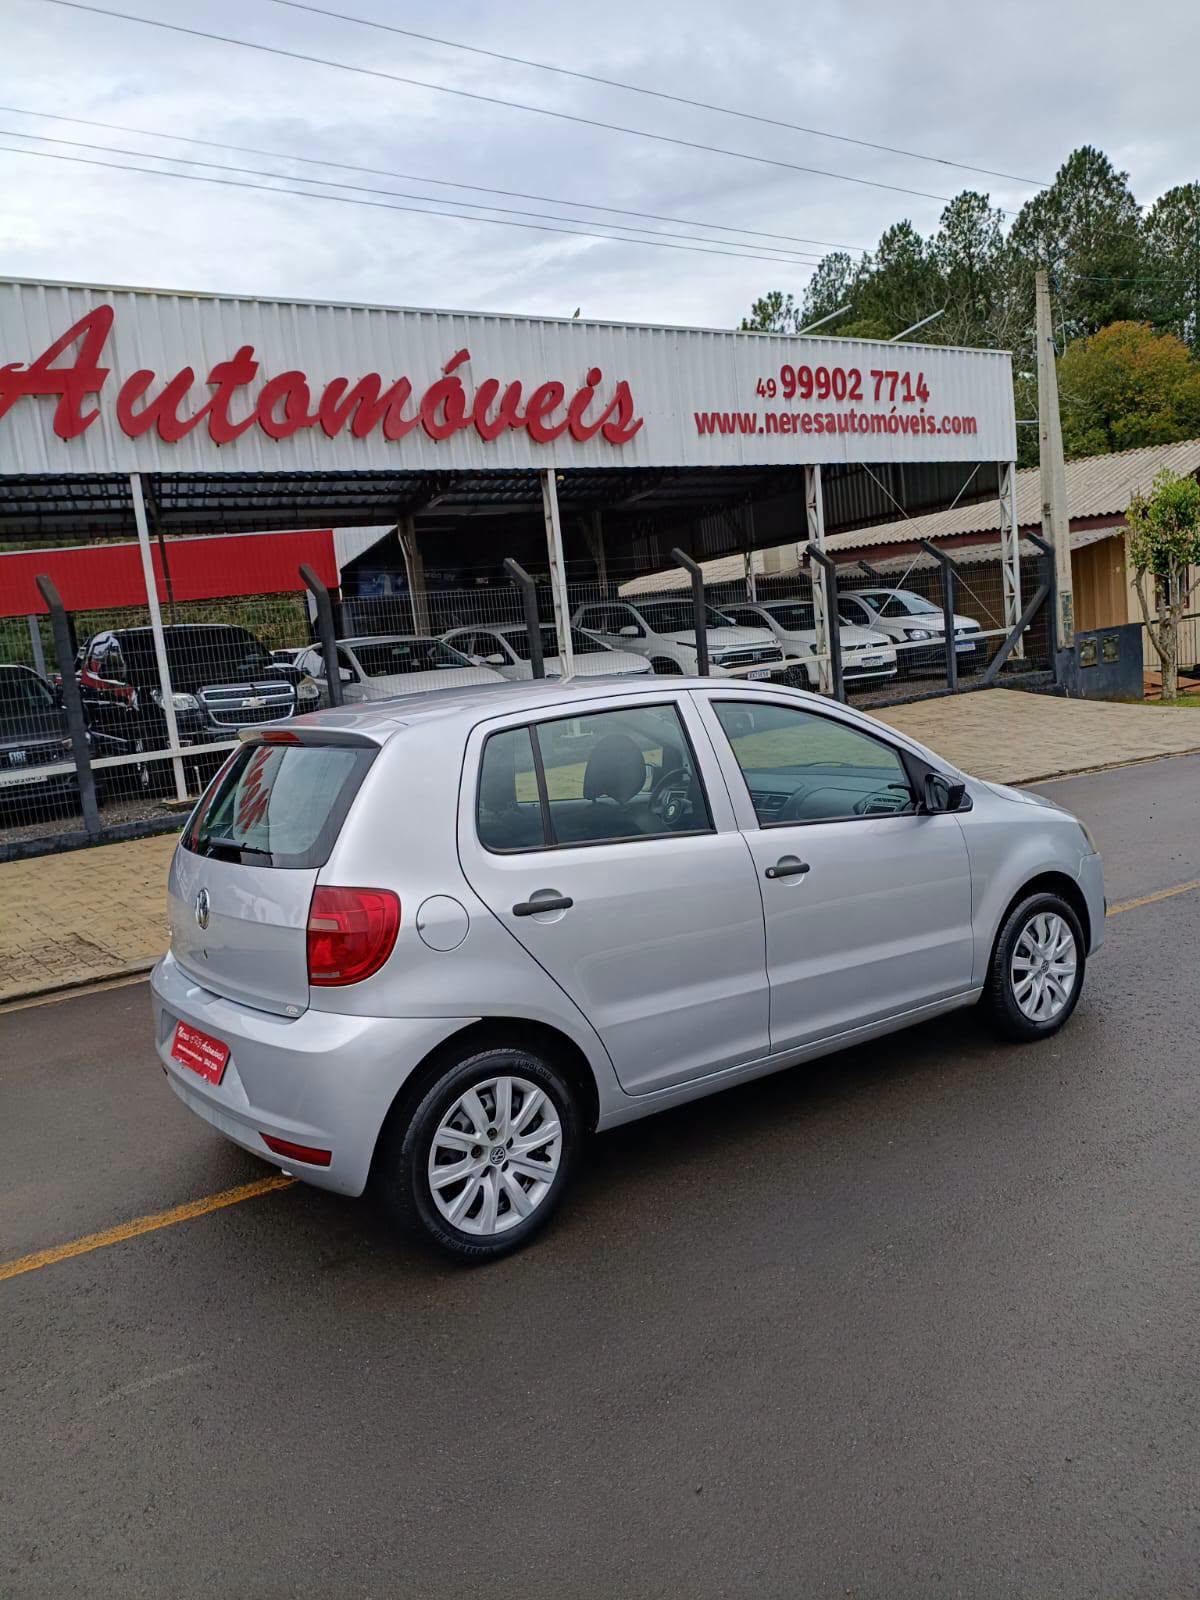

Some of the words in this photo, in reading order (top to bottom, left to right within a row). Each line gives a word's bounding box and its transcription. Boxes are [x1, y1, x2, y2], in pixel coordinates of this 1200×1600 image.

[0, 304, 644, 445] Automóveis
[756, 377, 777, 399] 49
[780, 364, 863, 401] 99902
[870, 370, 930, 402] 7714
[694, 406, 978, 434] www.neresautomóveis.com
